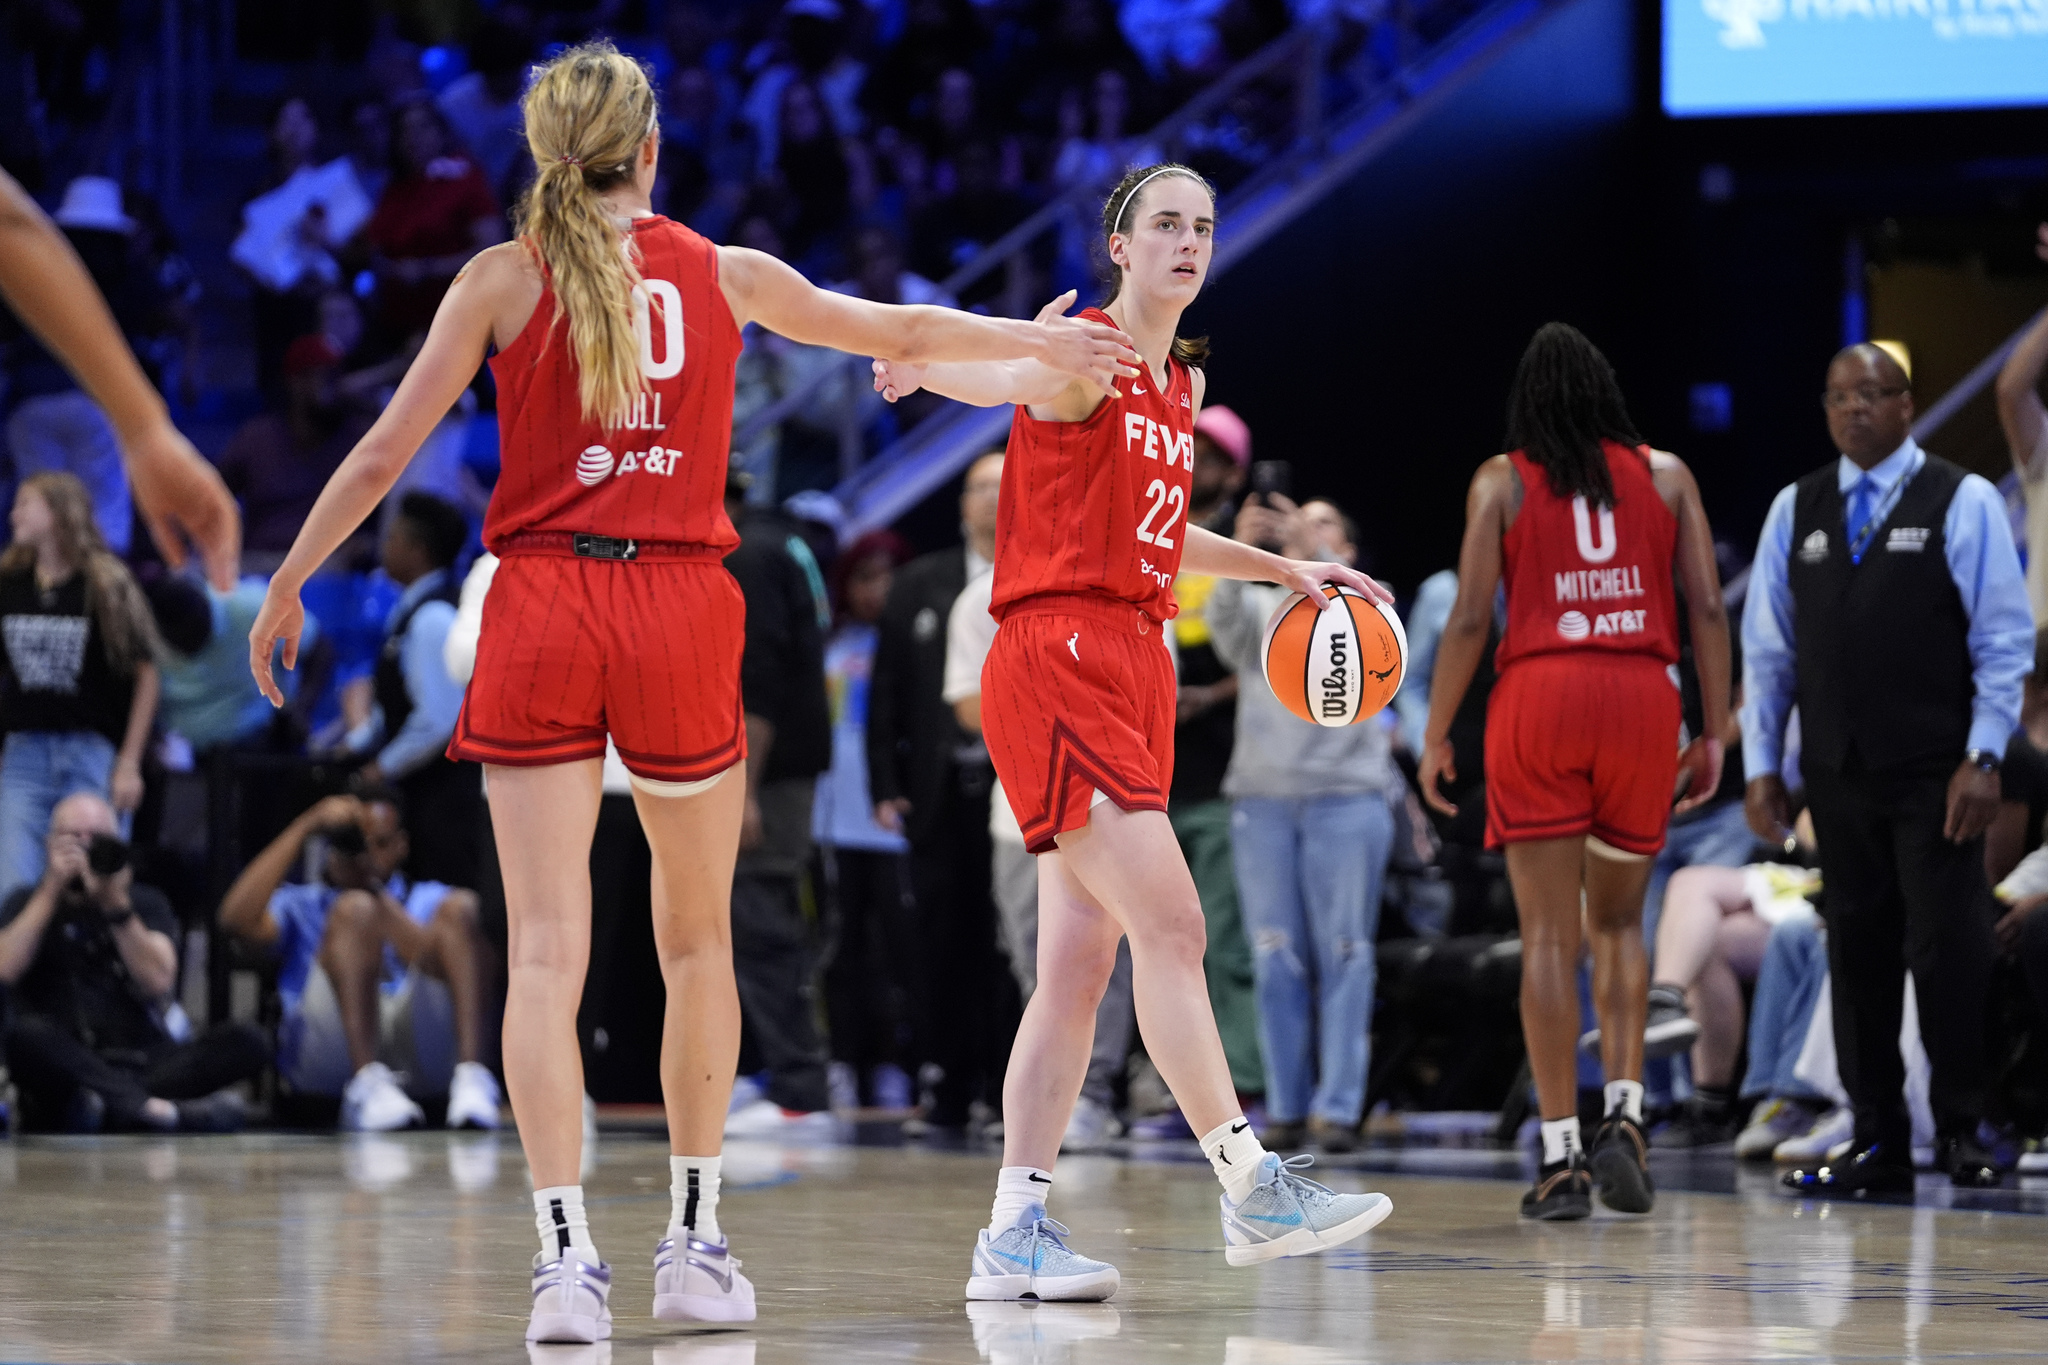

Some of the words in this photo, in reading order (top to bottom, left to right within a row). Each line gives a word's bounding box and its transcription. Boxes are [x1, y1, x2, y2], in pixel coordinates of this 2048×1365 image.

[1136, 478, 1184, 549] 22
[1554, 565, 1645, 604] MITCHELL
[1593, 608, 1648, 636] AT&T
[1321, 631, 1347, 718] Wilson
